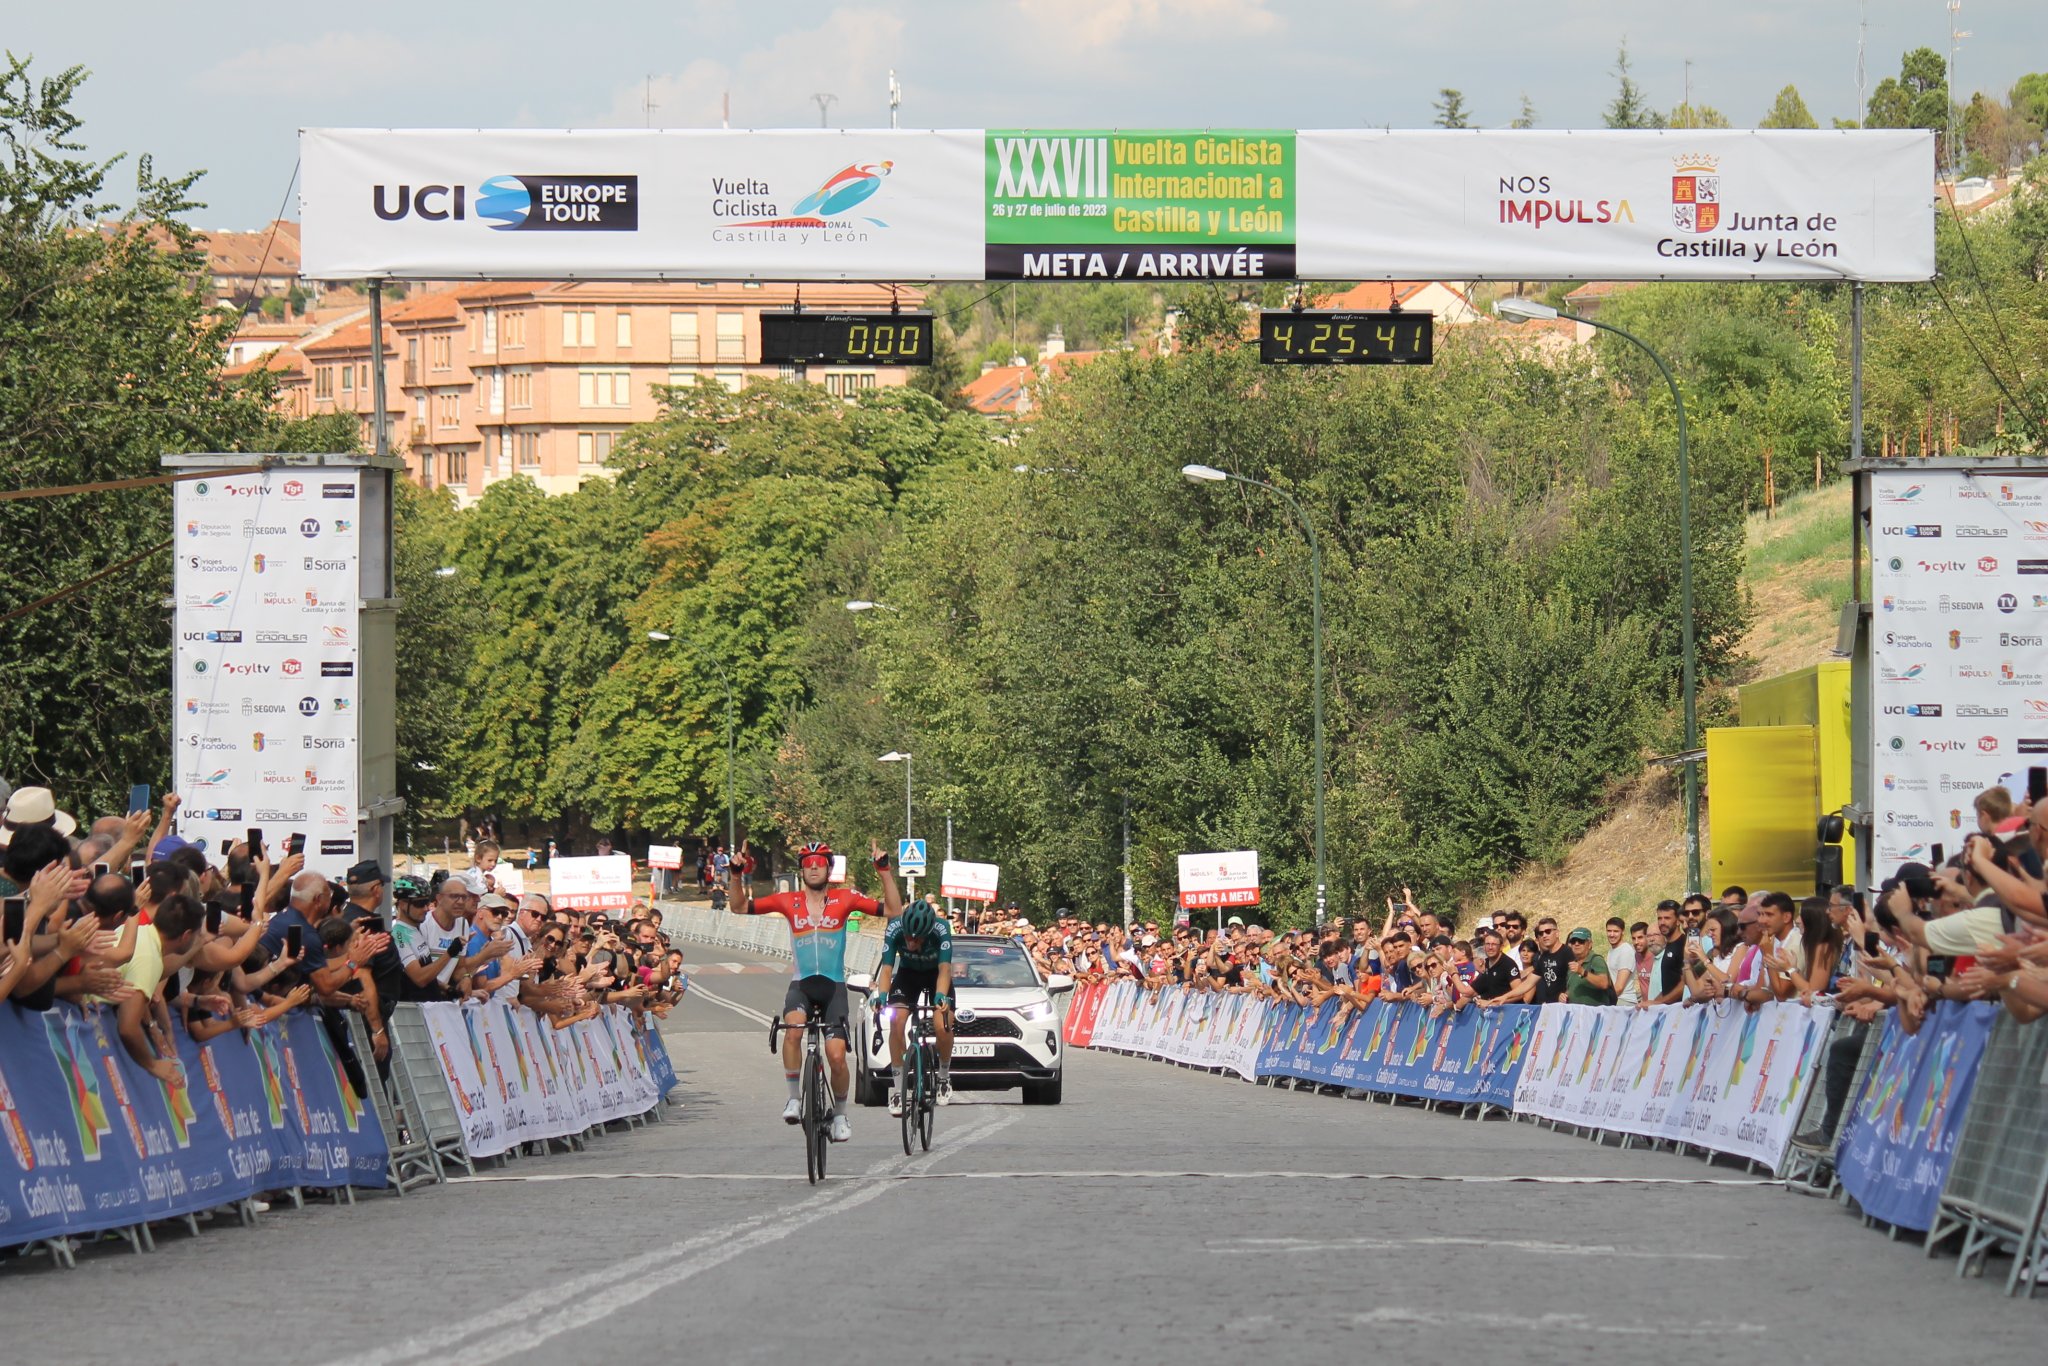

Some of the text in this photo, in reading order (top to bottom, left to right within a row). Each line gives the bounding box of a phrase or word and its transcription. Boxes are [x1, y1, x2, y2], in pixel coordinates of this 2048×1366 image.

[1113, 138, 1282, 165] Vuelta Ciclista
[994, 138, 1108, 198] XXXVII
[712, 178, 769, 195] Vuelta
[1113, 173, 1283, 199] Internacional a
[1499, 176, 1551, 194] NOS
[541, 185, 627, 203] EUROPE
[373, 185, 465, 221] UCI
[712, 199, 778, 216] Ciclista
[542, 204, 601, 222] TOUR
[992, 204, 1107, 218] 26 y 27 de julio de 2023
[1499, 200, 1635, 229] IMPULSA
[770, 221, 853, 229] INTERNACIONAL
[1113, 204, 1283, 235] Castilla y León
[1727, 211, 1837, 232] Junta de
[712, 229, 868, 244] Castilla y León
[1656, 238, 1838, 262] Castilla y León
[1023, 247, 1264, 277] META / ARRIVÉE
[238, 485, 272, 497] cyltv
[284, 483, 303, 497] Tgt
[200, 523, 231, 531] Diputación
[255, 527, 287, 535] SEGOVIA
[302, 521, 318, 532] TV
[1882, 527, 1903, 536] UCI
[208, 530, 231, 538] Segovia
[201, 558, 222, 567] viajes
[202, 564, 238, 572] sanabria
[315, 559, 346, 571] Soria
[1932, 561, 1966, 573] cyltv
[1979, 561, 1996, 572] Tgt
[264, 598, 296, 606] IMPULSA
[1951, 602, 1984, 610] SEGOVIA
[2000, 598, 2015, 608] TV
[184, 632, 204, 641] UCI
[2011, 635, 2042, 647] Soria
[1897, 640, 1932, 648] sanabria
[237, 663, 270, 675] cyltv
[283, 662, 301, 675] Tgt
[200, 702, 230, 710] Diputación
[254, 705, 286, 713] SEGOVIA
[301, 700, 317, 711] TV
[1884, 706, 1904, 715] UCI
[202, 736, 222, 744] viajes
[314, 737, 345, 749] Soria
[1979, 740, 1997, 750] Tgt
[201, 742, 237, 750] sanabria
[1934, 740, 1966, 752] cyltv
[264, 776, 296, 784] IMPULSA
[1952, 781, 1984, 790] SEGOVIA
[184, 810, 204, 819] UCI
[256, 812, 307, 820] CADALSA
[1898, 813, 1918, 821] viajes
[1897, 819, 1934, 827] sanabria
[556, 895, 628, 908] 50 MTS A META
[1185, 891, 1255, 905] 50 MTS A META
[885, 921, 901, 936] KERN
[973, 1045, 991, 1054] LXY
